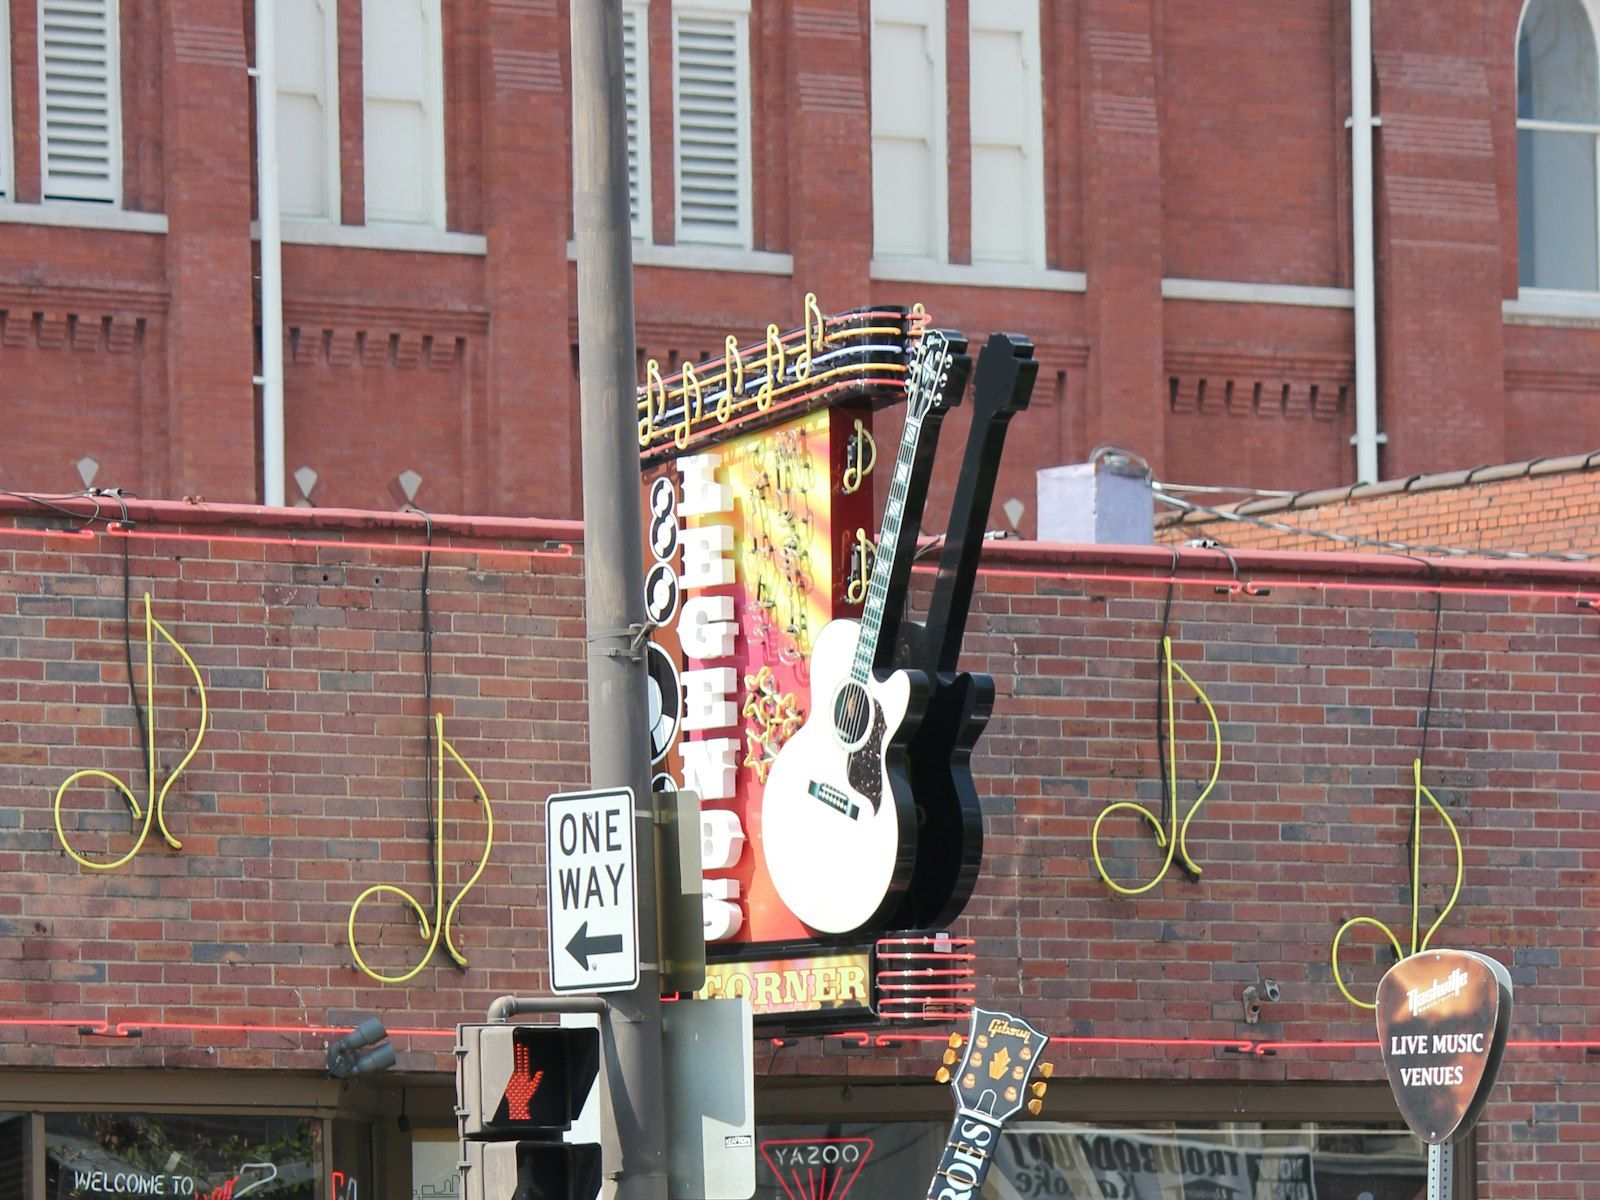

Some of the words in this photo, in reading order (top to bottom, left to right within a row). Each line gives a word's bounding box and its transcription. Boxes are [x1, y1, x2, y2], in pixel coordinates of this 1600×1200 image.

[677, 453, 746, 941] LEGENDS
[560, 809, 621, 856] ONE
[559, 863, 625, 910] WAY
[699, 966, 867, 1005] CORNER
[1391, 1035, 1428, 1055] LIVE
[1432, 1033, 1483, 1054] MUSIC
[1400, 1066, 1463, 1087] VENUES
[775, 1144, 859, 1165] YAZOO
[74, 1170, 164, 1195] WELCOME
[172, 1175, 194, 1195] TO
